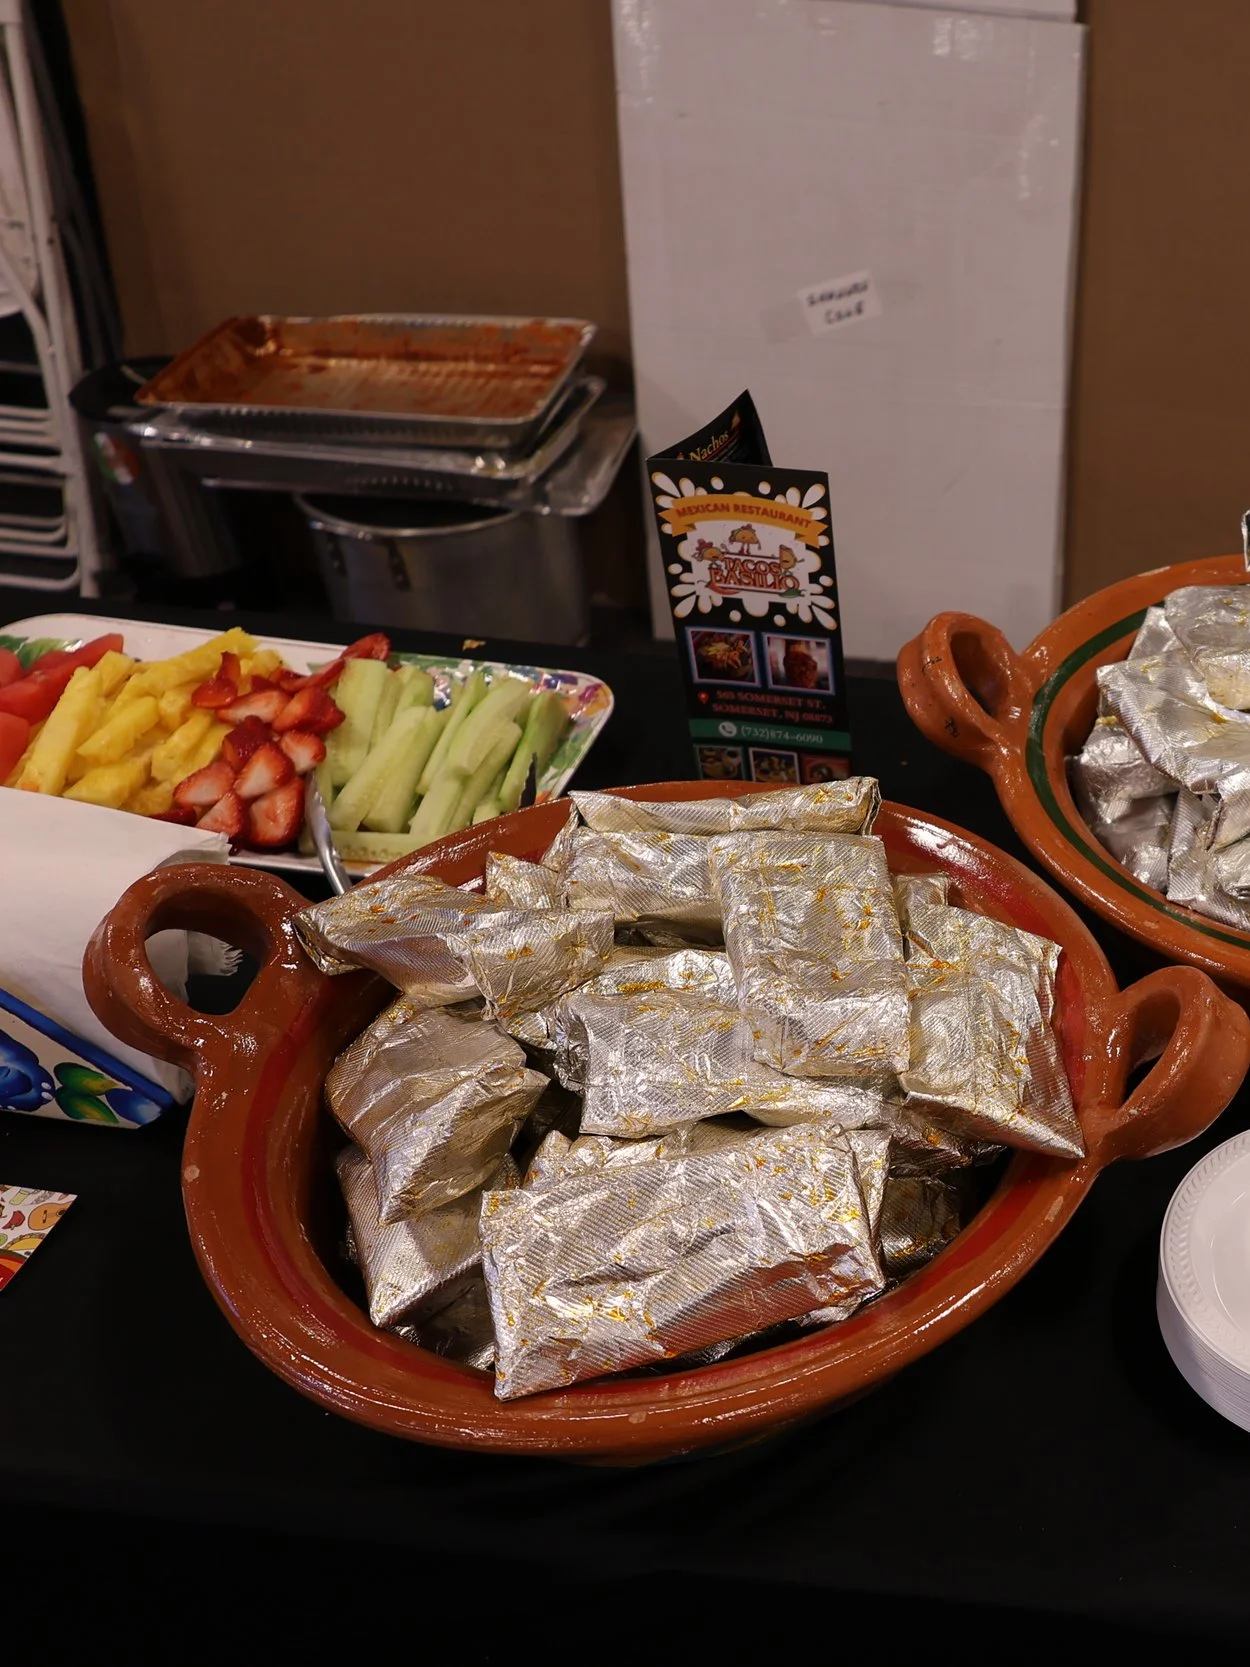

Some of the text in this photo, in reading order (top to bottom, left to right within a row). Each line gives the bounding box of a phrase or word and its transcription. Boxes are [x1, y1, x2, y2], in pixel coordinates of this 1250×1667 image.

[688, 430, 729, 461] Nachos
[676, 503, 812, 529] MEXICAN RESTAURANT
[724, 558, 782, 576] TACOS
[708, 567, 800, 590] BASILIO
[738, 692, 804, 707] SOMERSET
[807, 699, 826, 710] ST.
[785, 711, 800, 723] NJ
[741, 725, 824, 744] (732)874-6090
